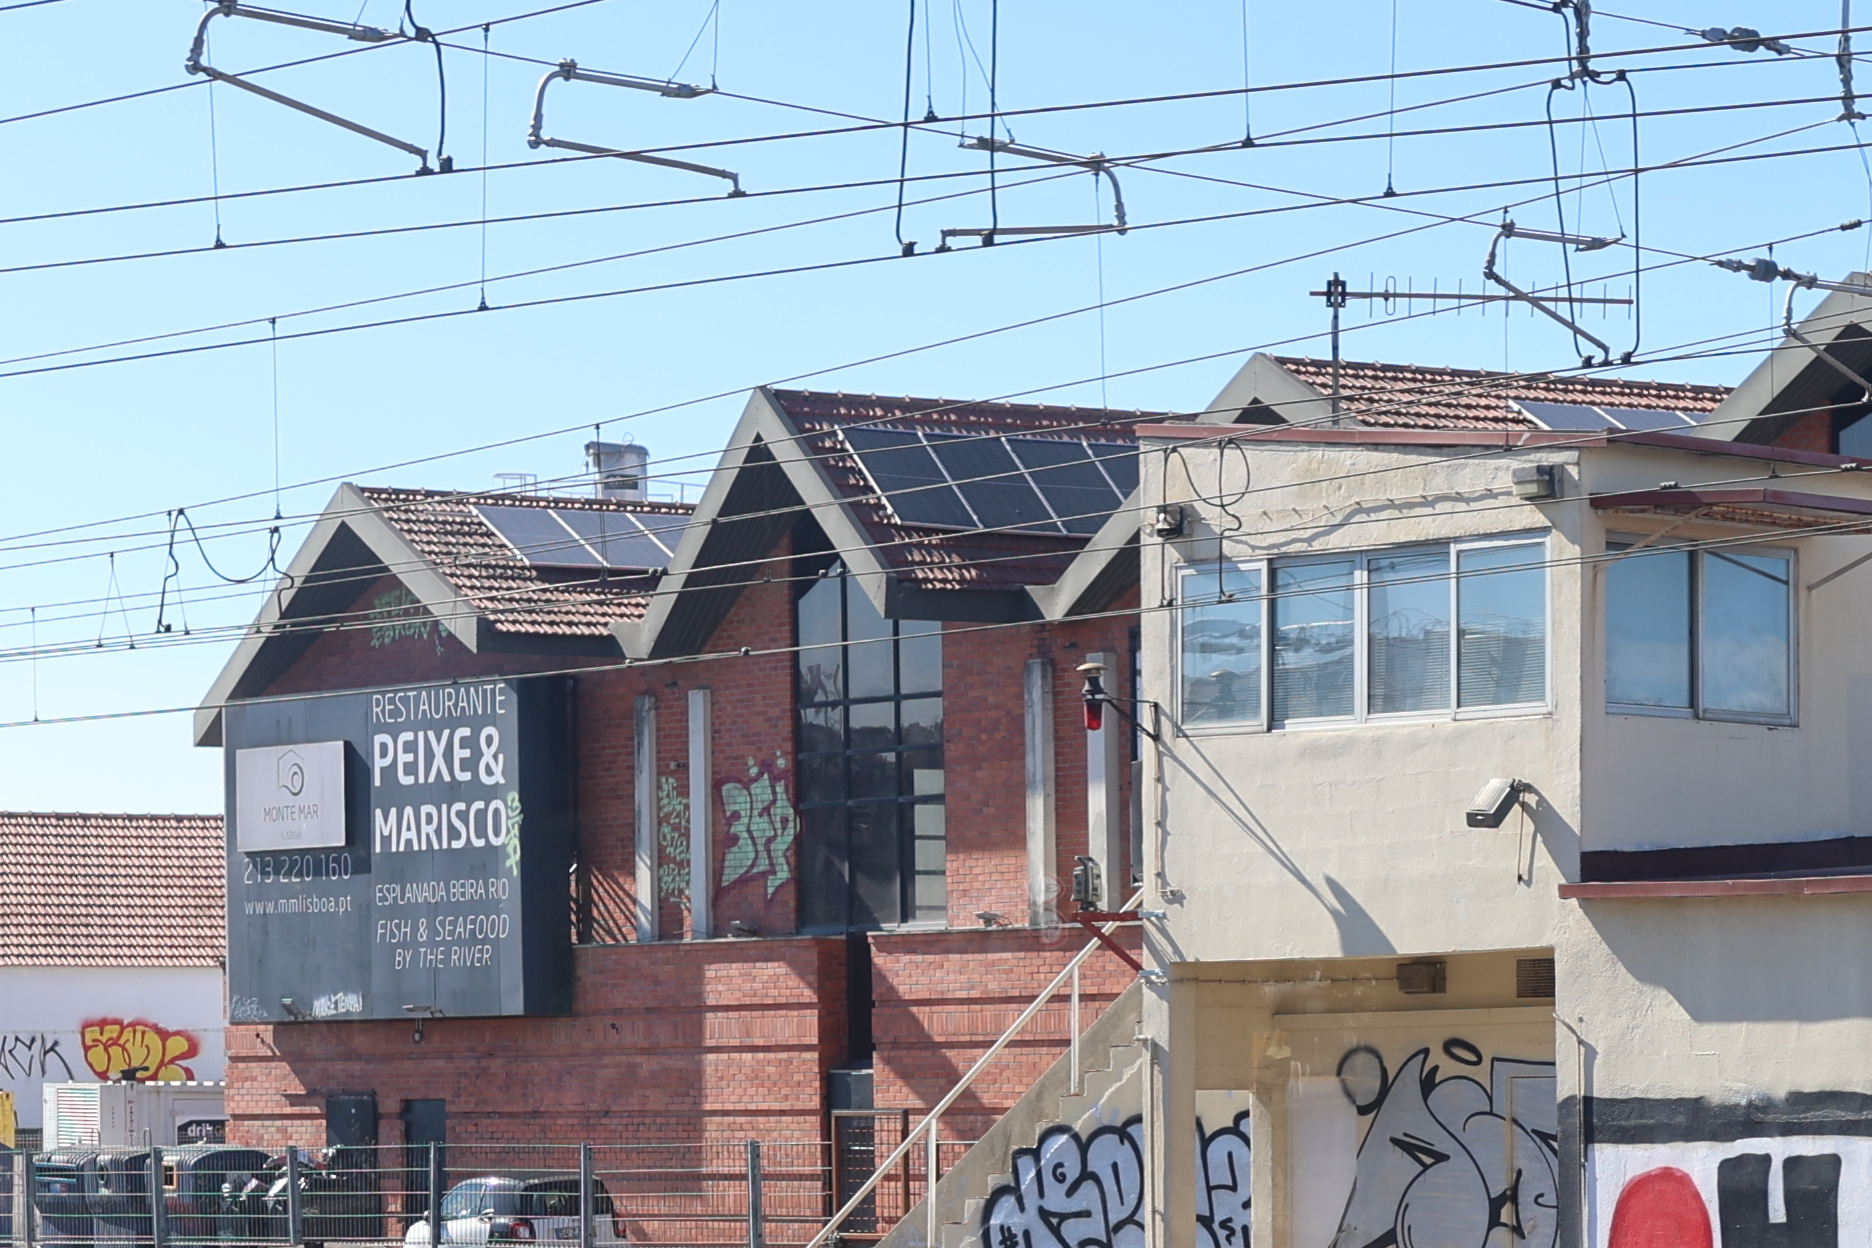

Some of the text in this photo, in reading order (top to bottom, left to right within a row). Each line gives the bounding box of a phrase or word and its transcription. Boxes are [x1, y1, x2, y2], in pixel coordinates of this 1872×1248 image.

[373, 683, 506, 723] RESTAURANTE
[373, 725, 506, 787] PEIXE &
[263, 803, 319, 823] MONTE MAR
[375, 799, 507, 853] MARISCO
[281, 829, 302, 841] Lisboa
[243, 852, 352, 884] 213 220 160
[244, 894, 352, 915] www.mmlisboa.pt
[375, 878, 509, 905] ESPLANADA BEIRA RIO
[377, 914, 510, 943] FISH & SEAFOOD
[395, 944, 492, 969] BY THE RIVER
